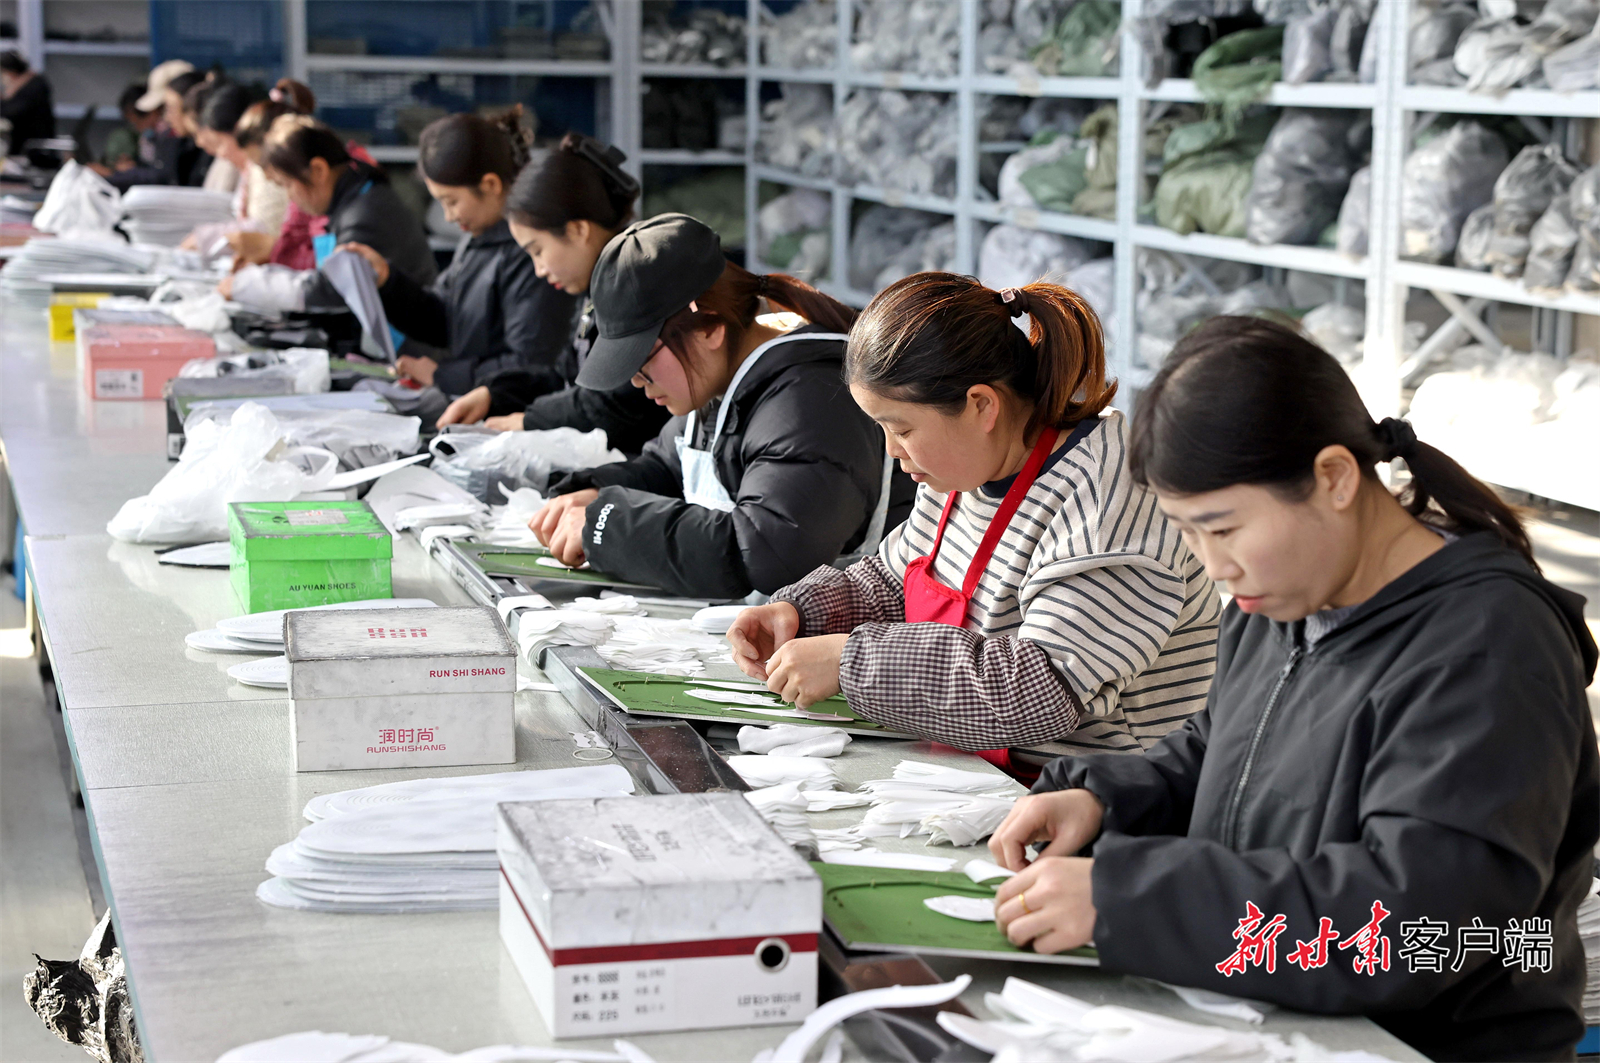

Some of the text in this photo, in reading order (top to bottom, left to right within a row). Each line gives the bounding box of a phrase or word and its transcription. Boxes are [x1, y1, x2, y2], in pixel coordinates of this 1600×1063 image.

[592, 503, 615, 545] COCO MI
[327, 582, 357, 590] SHOES
[429, 667, 506, 678] RUN SHI SHANG
[378, 727, 434, 744] 润时尚
[366, 743, 447, 754] RUNSHISHANG
